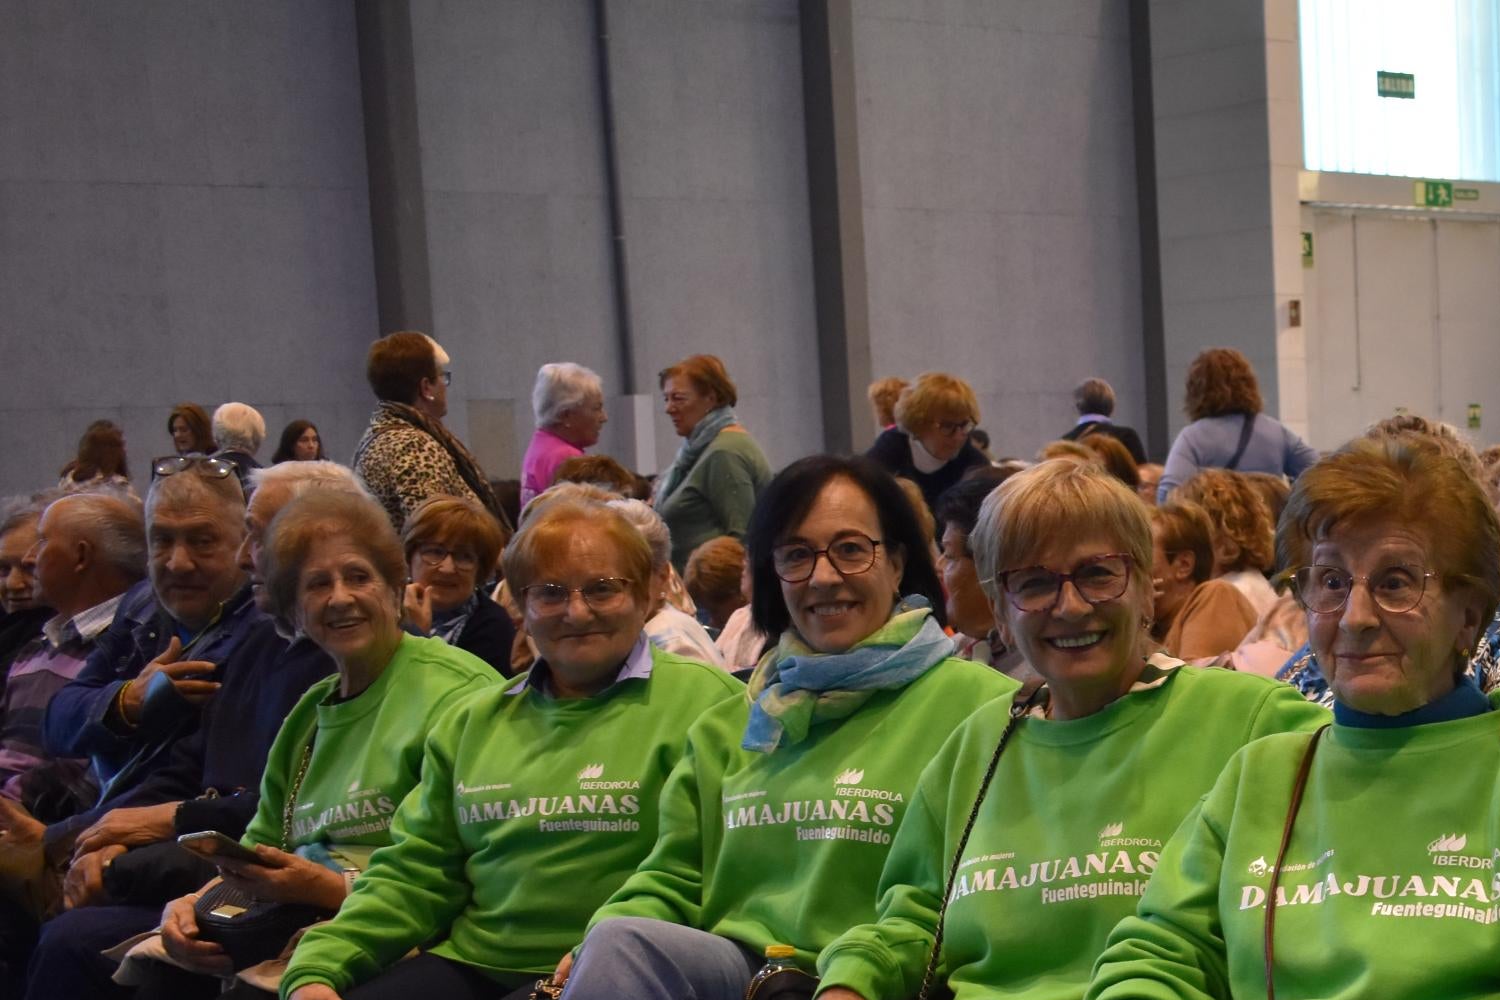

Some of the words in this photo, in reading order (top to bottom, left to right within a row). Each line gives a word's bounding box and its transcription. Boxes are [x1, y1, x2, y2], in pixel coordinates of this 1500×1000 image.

[580, 780, 640, 790] IBERDROLA
[835, 787, 904, 802] IBERDROLA
[458, 794, 640, 825] DAMAJUANAS
[540, 818, 640, 832] Fuenteguinaldo
[797, 824, 891, 845] Fuenteguinaldo
[1100, 838, 1162, 848] IBERDROLA
[1042, 878, 1149, 904] Fuenteguinald
